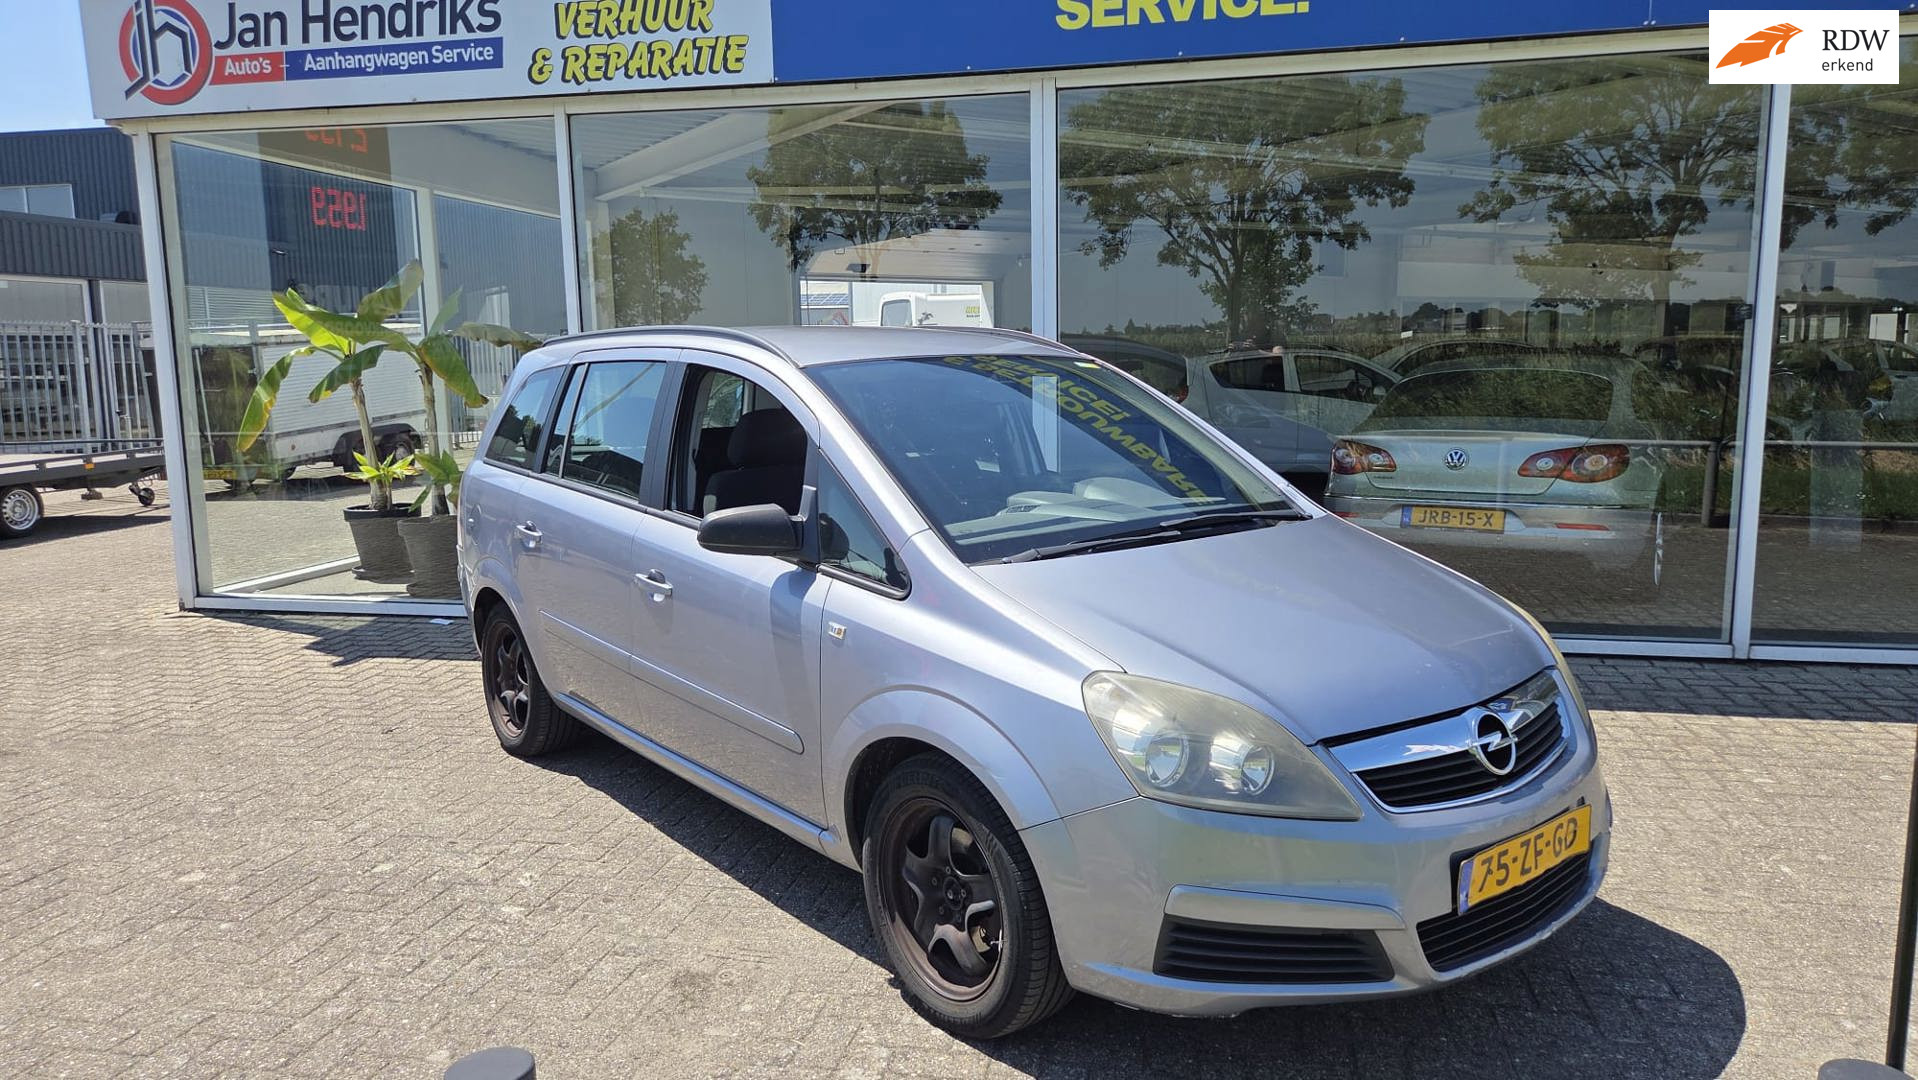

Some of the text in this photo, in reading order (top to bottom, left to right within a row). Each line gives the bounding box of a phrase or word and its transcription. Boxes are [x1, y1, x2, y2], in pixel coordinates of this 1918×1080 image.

[213, 0, 502, 50] Jan Hendriks
[554, 0, 714, 40] VERHUUR
[1055, 0, 1310, 30] SERV
[224, 57, 272, 76] Auto's
[304, 49, 429, 72] Aanhangwagen
[431, 42, 494, 64] Service
[527, 34, 749, 85] & REPARATIE
[1418, 509, 1494, 528] JRB-15-X
[1478, 816, 1579, 893] 75-ZF-GD
